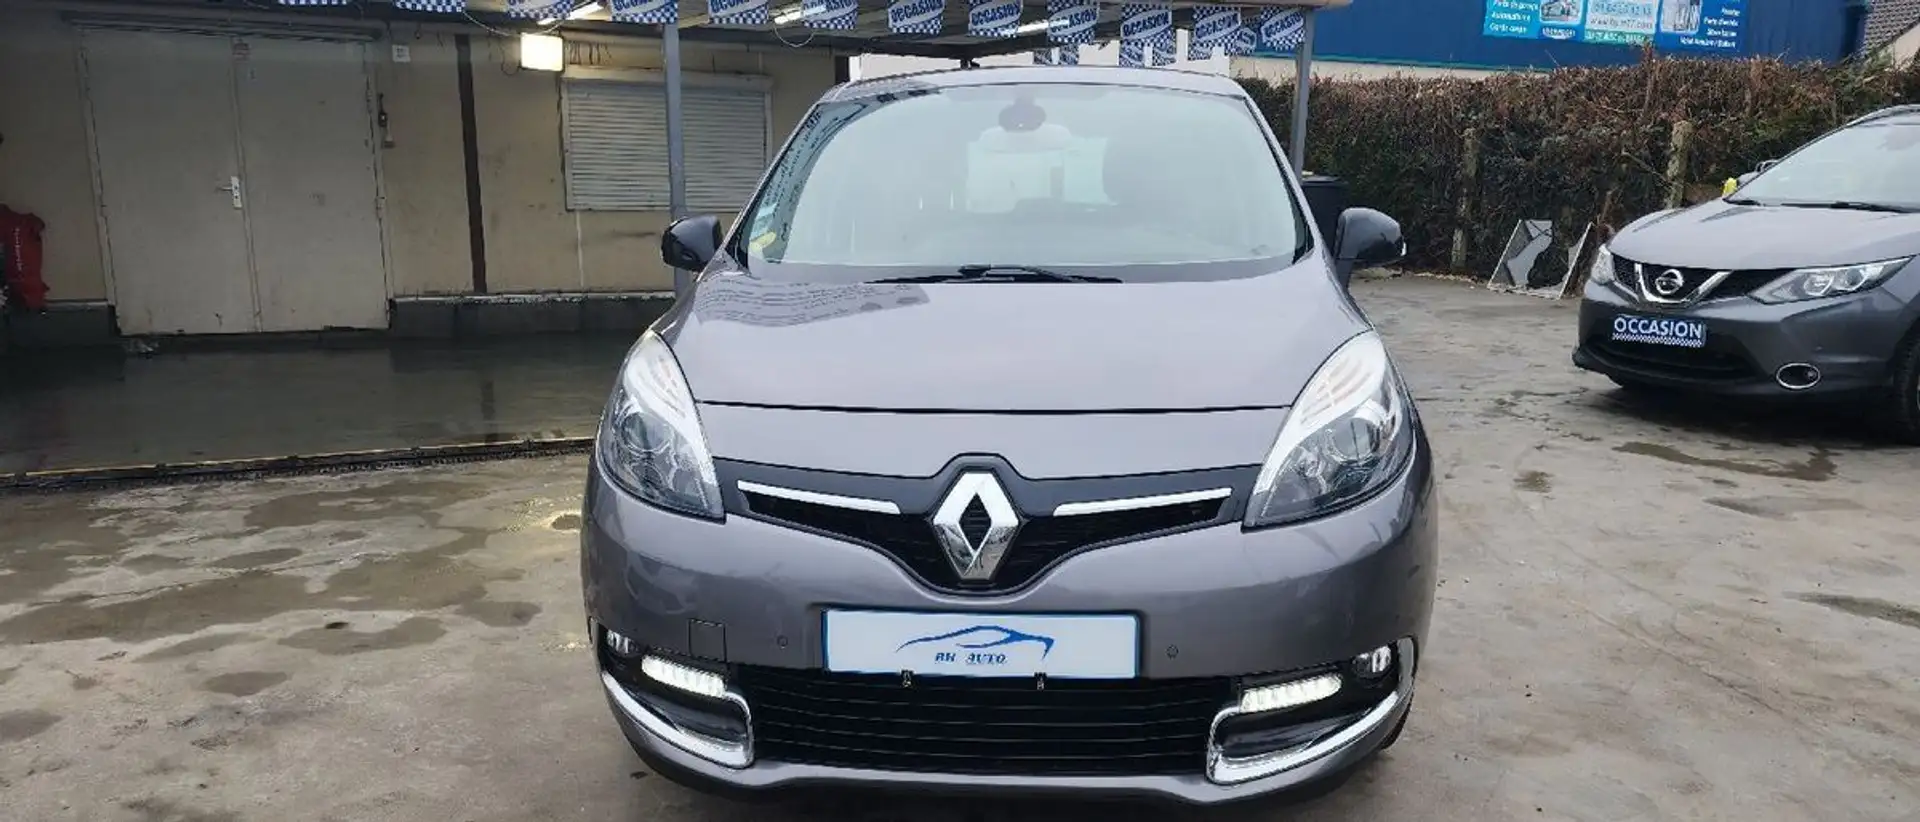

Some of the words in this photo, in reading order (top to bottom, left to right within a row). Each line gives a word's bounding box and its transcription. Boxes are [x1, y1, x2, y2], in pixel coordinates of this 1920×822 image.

[971, 3, 1020, 26] OCCASION
[1123, 11, 1169, 36] OCCASION
[1196, 13, 1238, 38] OCCASION
[1614, 317, 1702, 338] OCCASION
[966, 652, 1007, 665] AUTO
